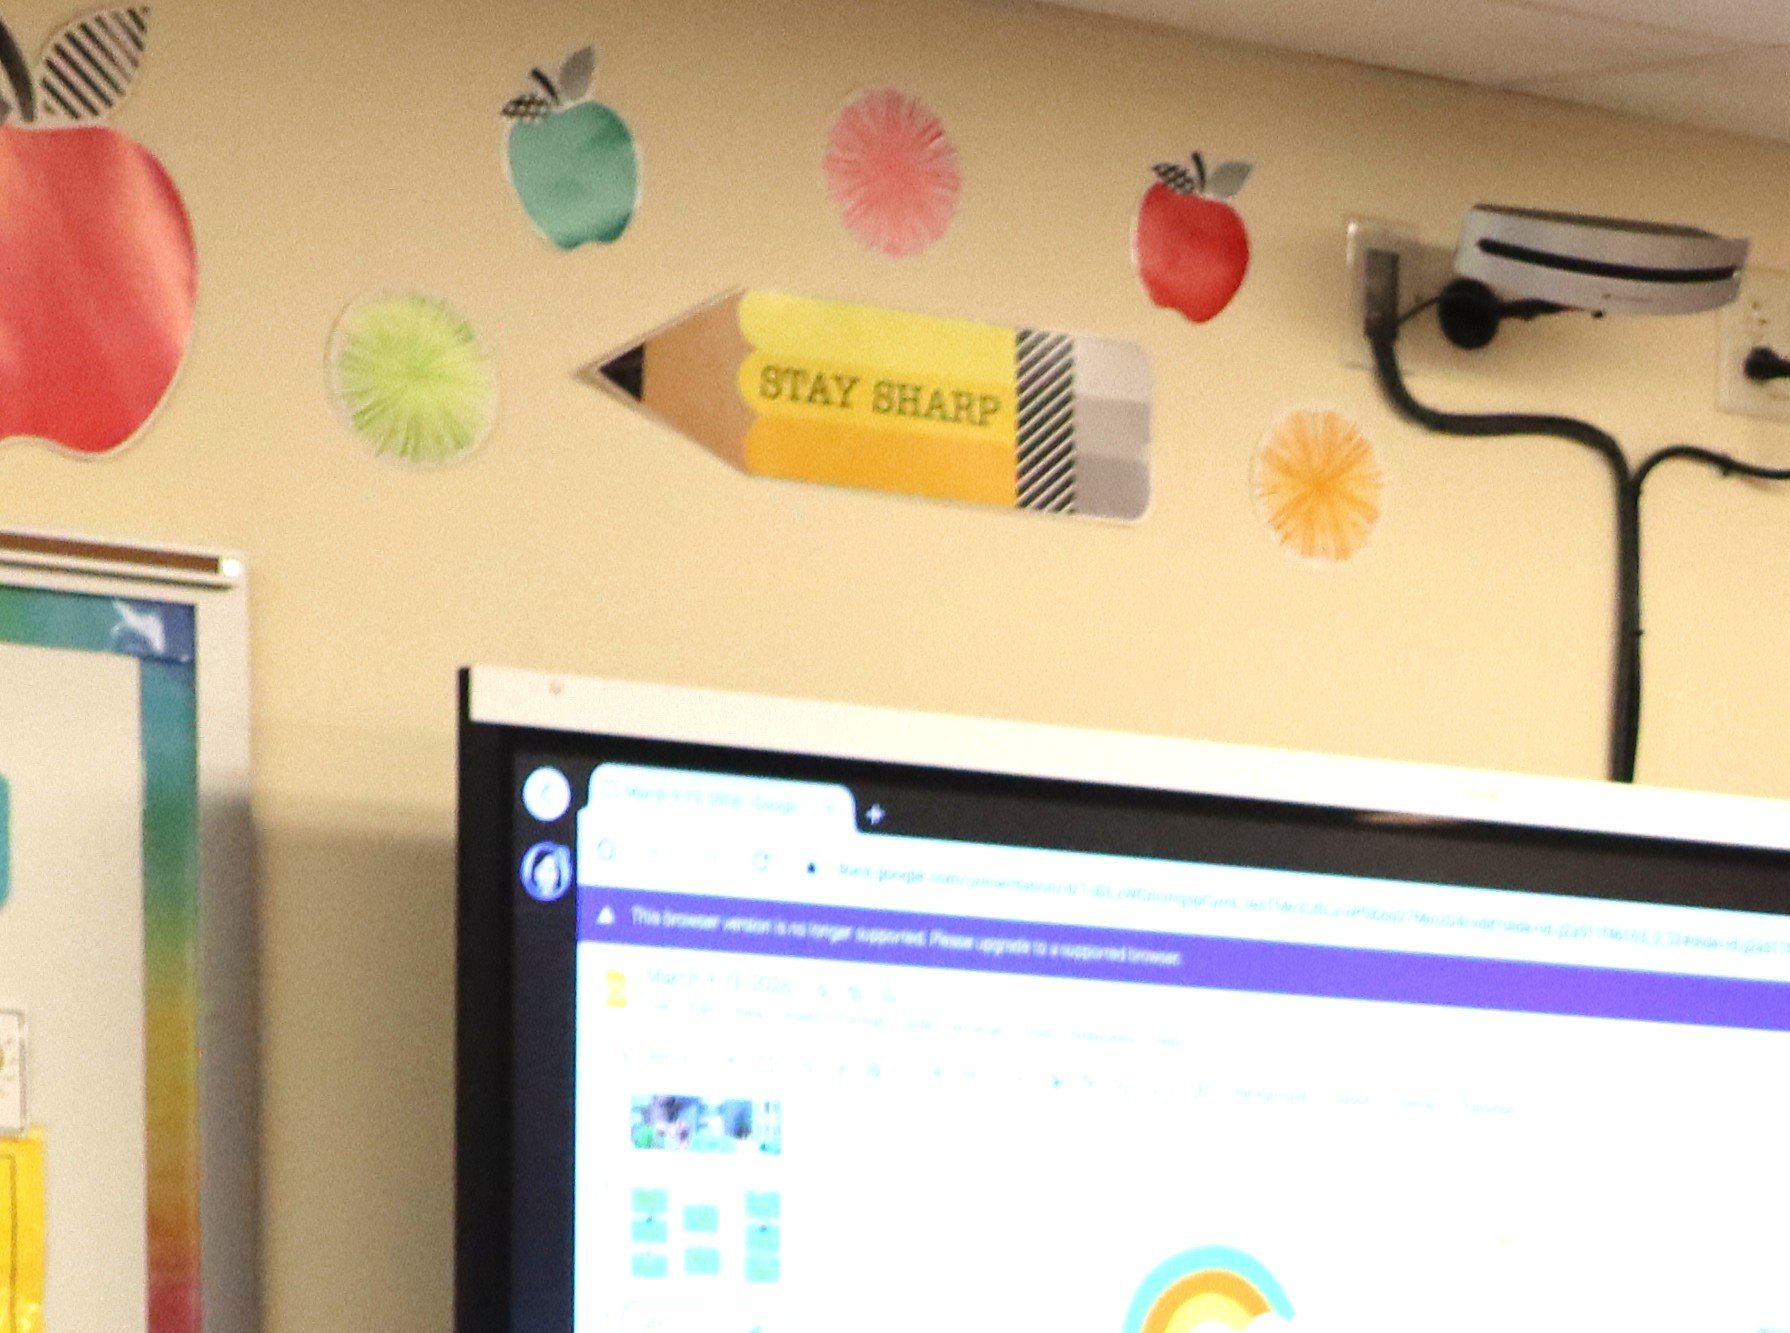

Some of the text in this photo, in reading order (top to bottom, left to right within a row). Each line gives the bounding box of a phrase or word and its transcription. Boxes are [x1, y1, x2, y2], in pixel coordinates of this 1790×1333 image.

[758, 363, 1003, 430] STAY SHARP
[662, 910, 719, 929] browser
